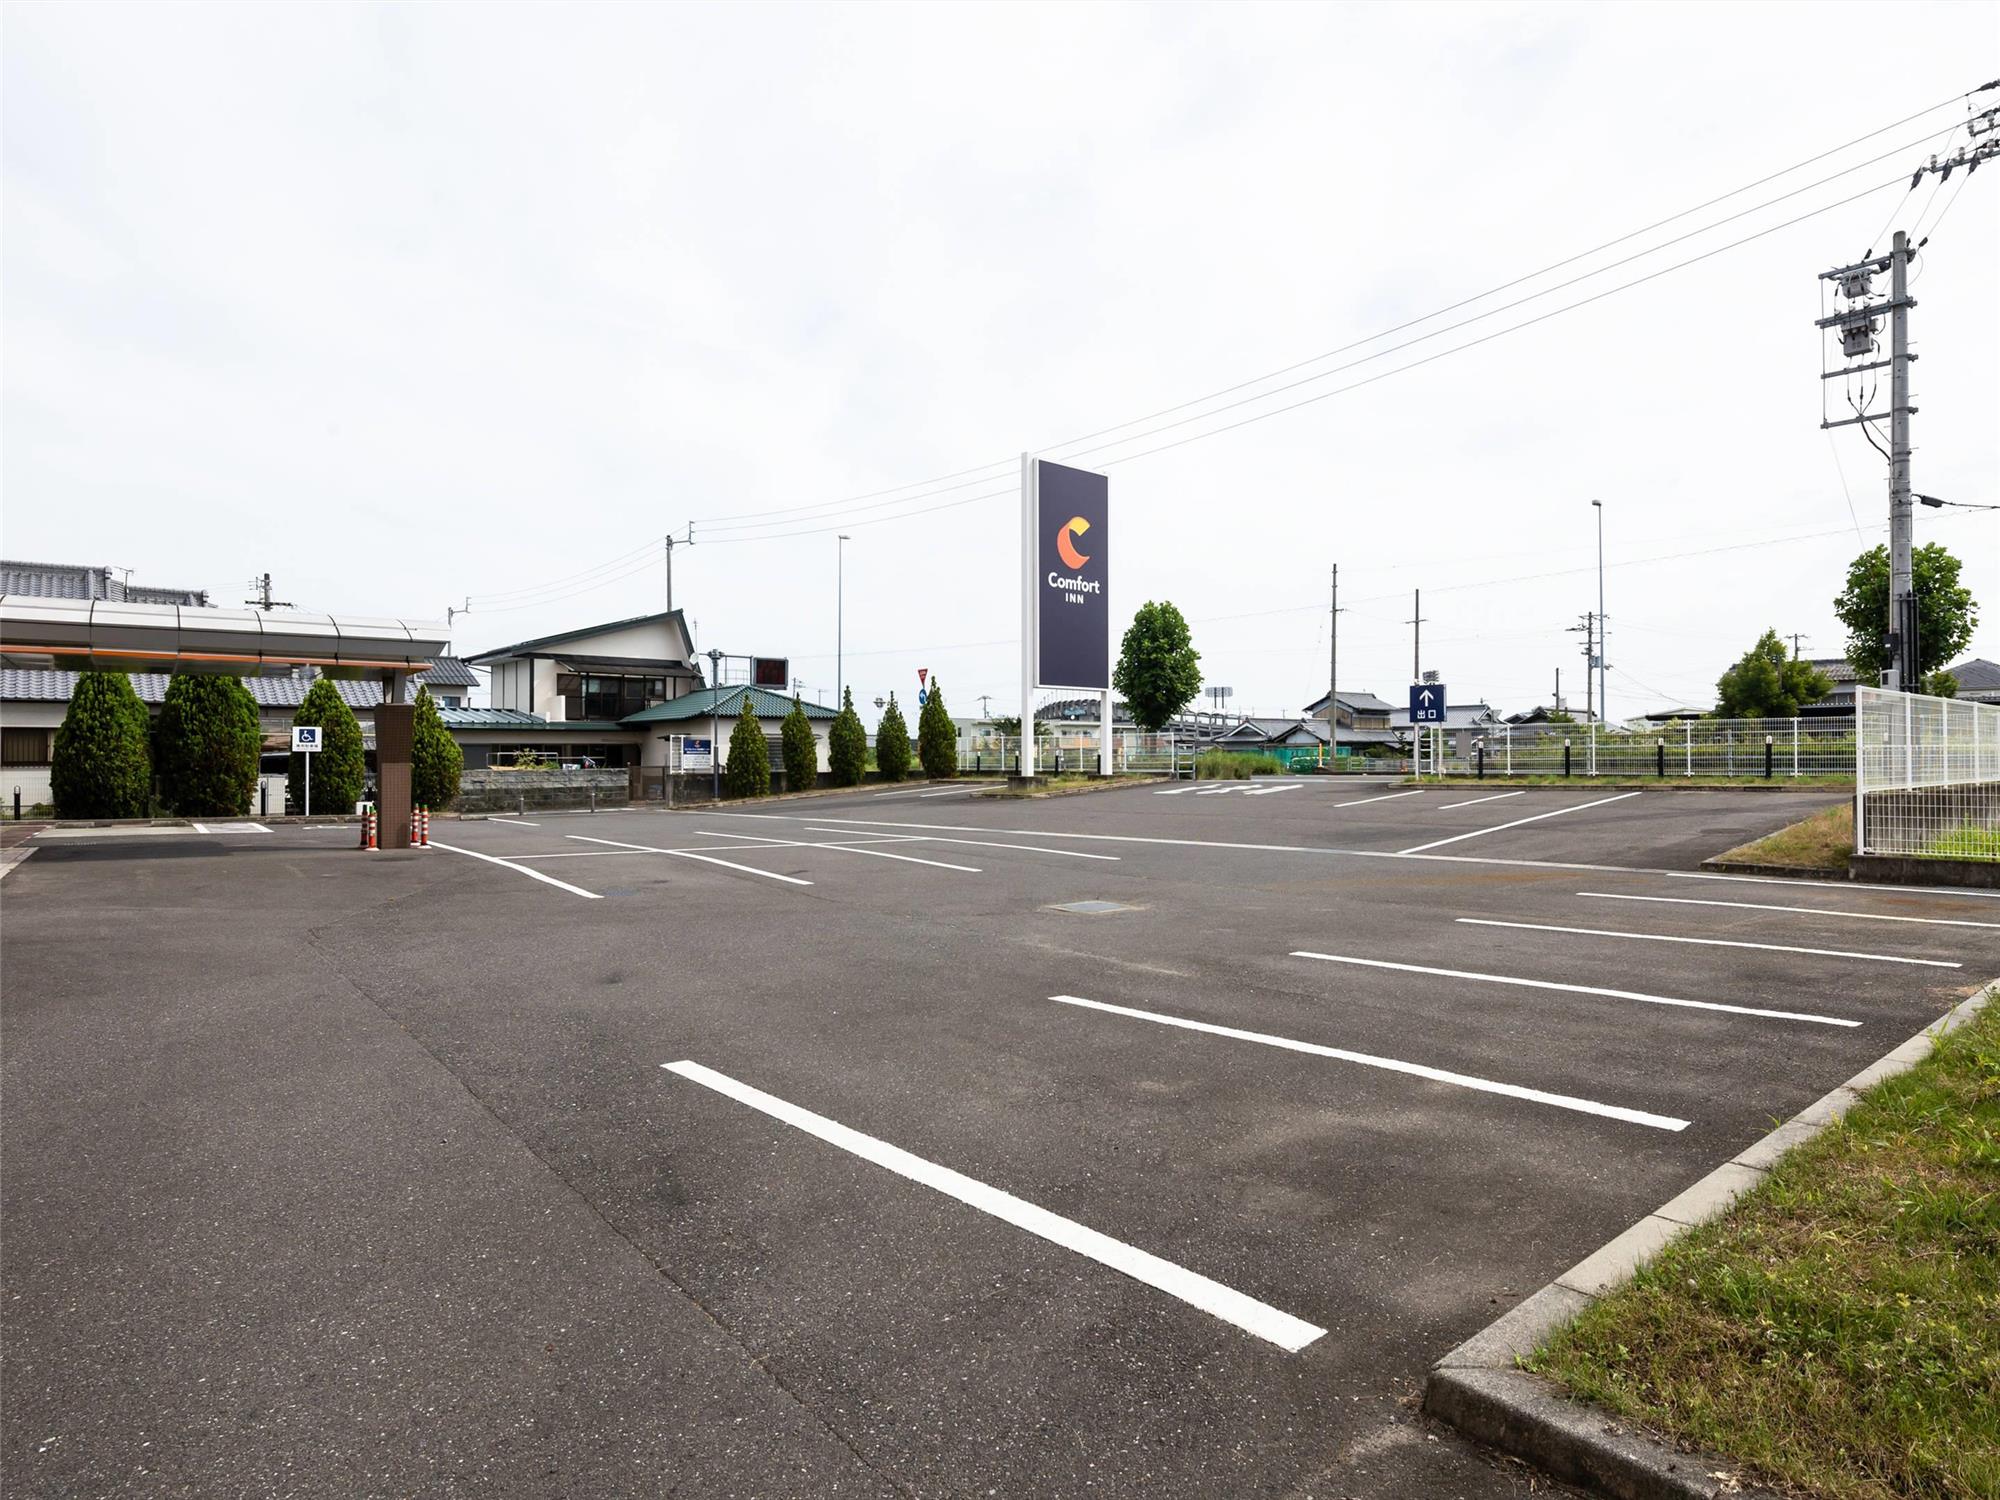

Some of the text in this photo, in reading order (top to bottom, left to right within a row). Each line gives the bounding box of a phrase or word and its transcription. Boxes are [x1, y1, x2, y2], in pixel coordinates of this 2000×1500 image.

[1048, 572, 1100, 594] Comfort
[1065, 592, 1084, 604] INN
[1417, 709, 1437, 719] 出口
